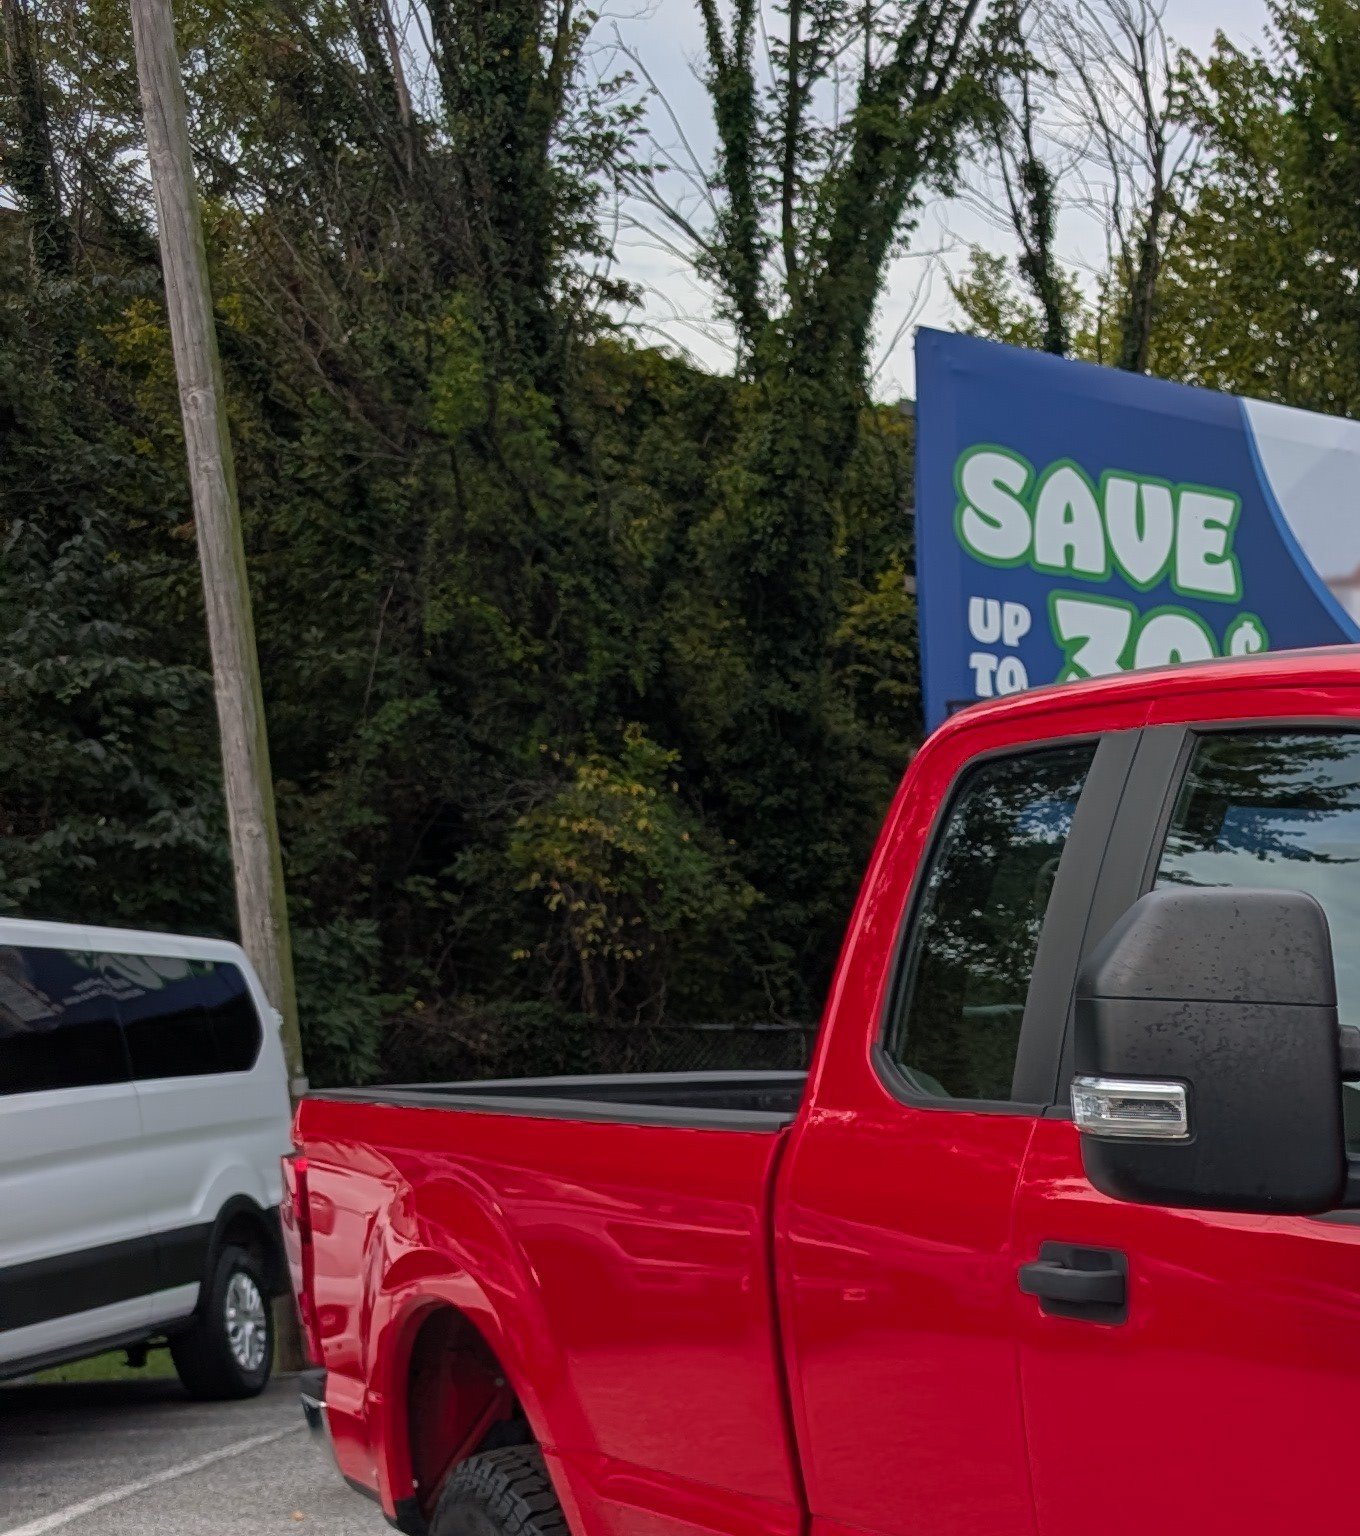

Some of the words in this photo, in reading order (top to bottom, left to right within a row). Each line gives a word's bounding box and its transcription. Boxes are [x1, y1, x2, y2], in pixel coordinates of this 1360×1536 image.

[959, 448, 1239, 598] SAVE
[968, 595, 1032, 648] UP
[968, 651, 1029, 697] TO
